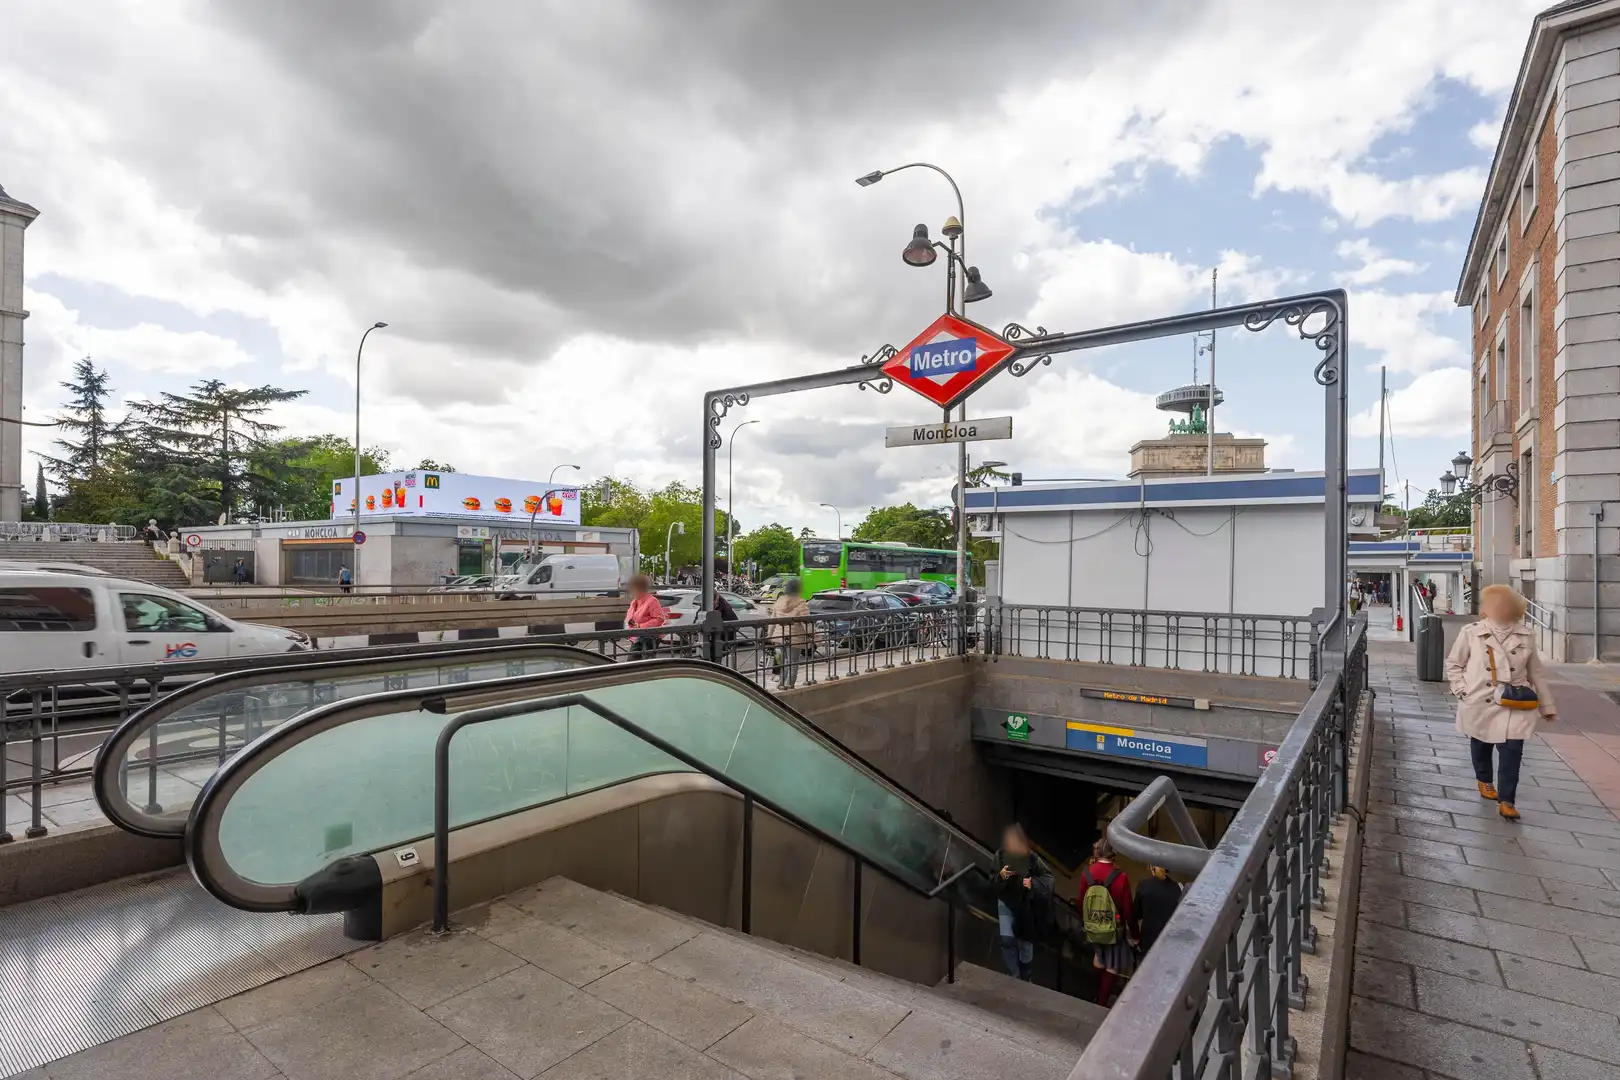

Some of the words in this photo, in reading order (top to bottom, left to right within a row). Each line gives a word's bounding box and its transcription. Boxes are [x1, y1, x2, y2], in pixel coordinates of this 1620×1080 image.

[914, 349, 971, 371] Metro
[913, 425, 977, 441] Moncloa
[304, 528, 338, 538] MONCLOA
[165, 643, 198, 658] HG
[1104, 692, 1125, 700] Metro
[1140, 695, 1167, 705] Madrid
[1117, 737, 1172, 754] Moncloa
